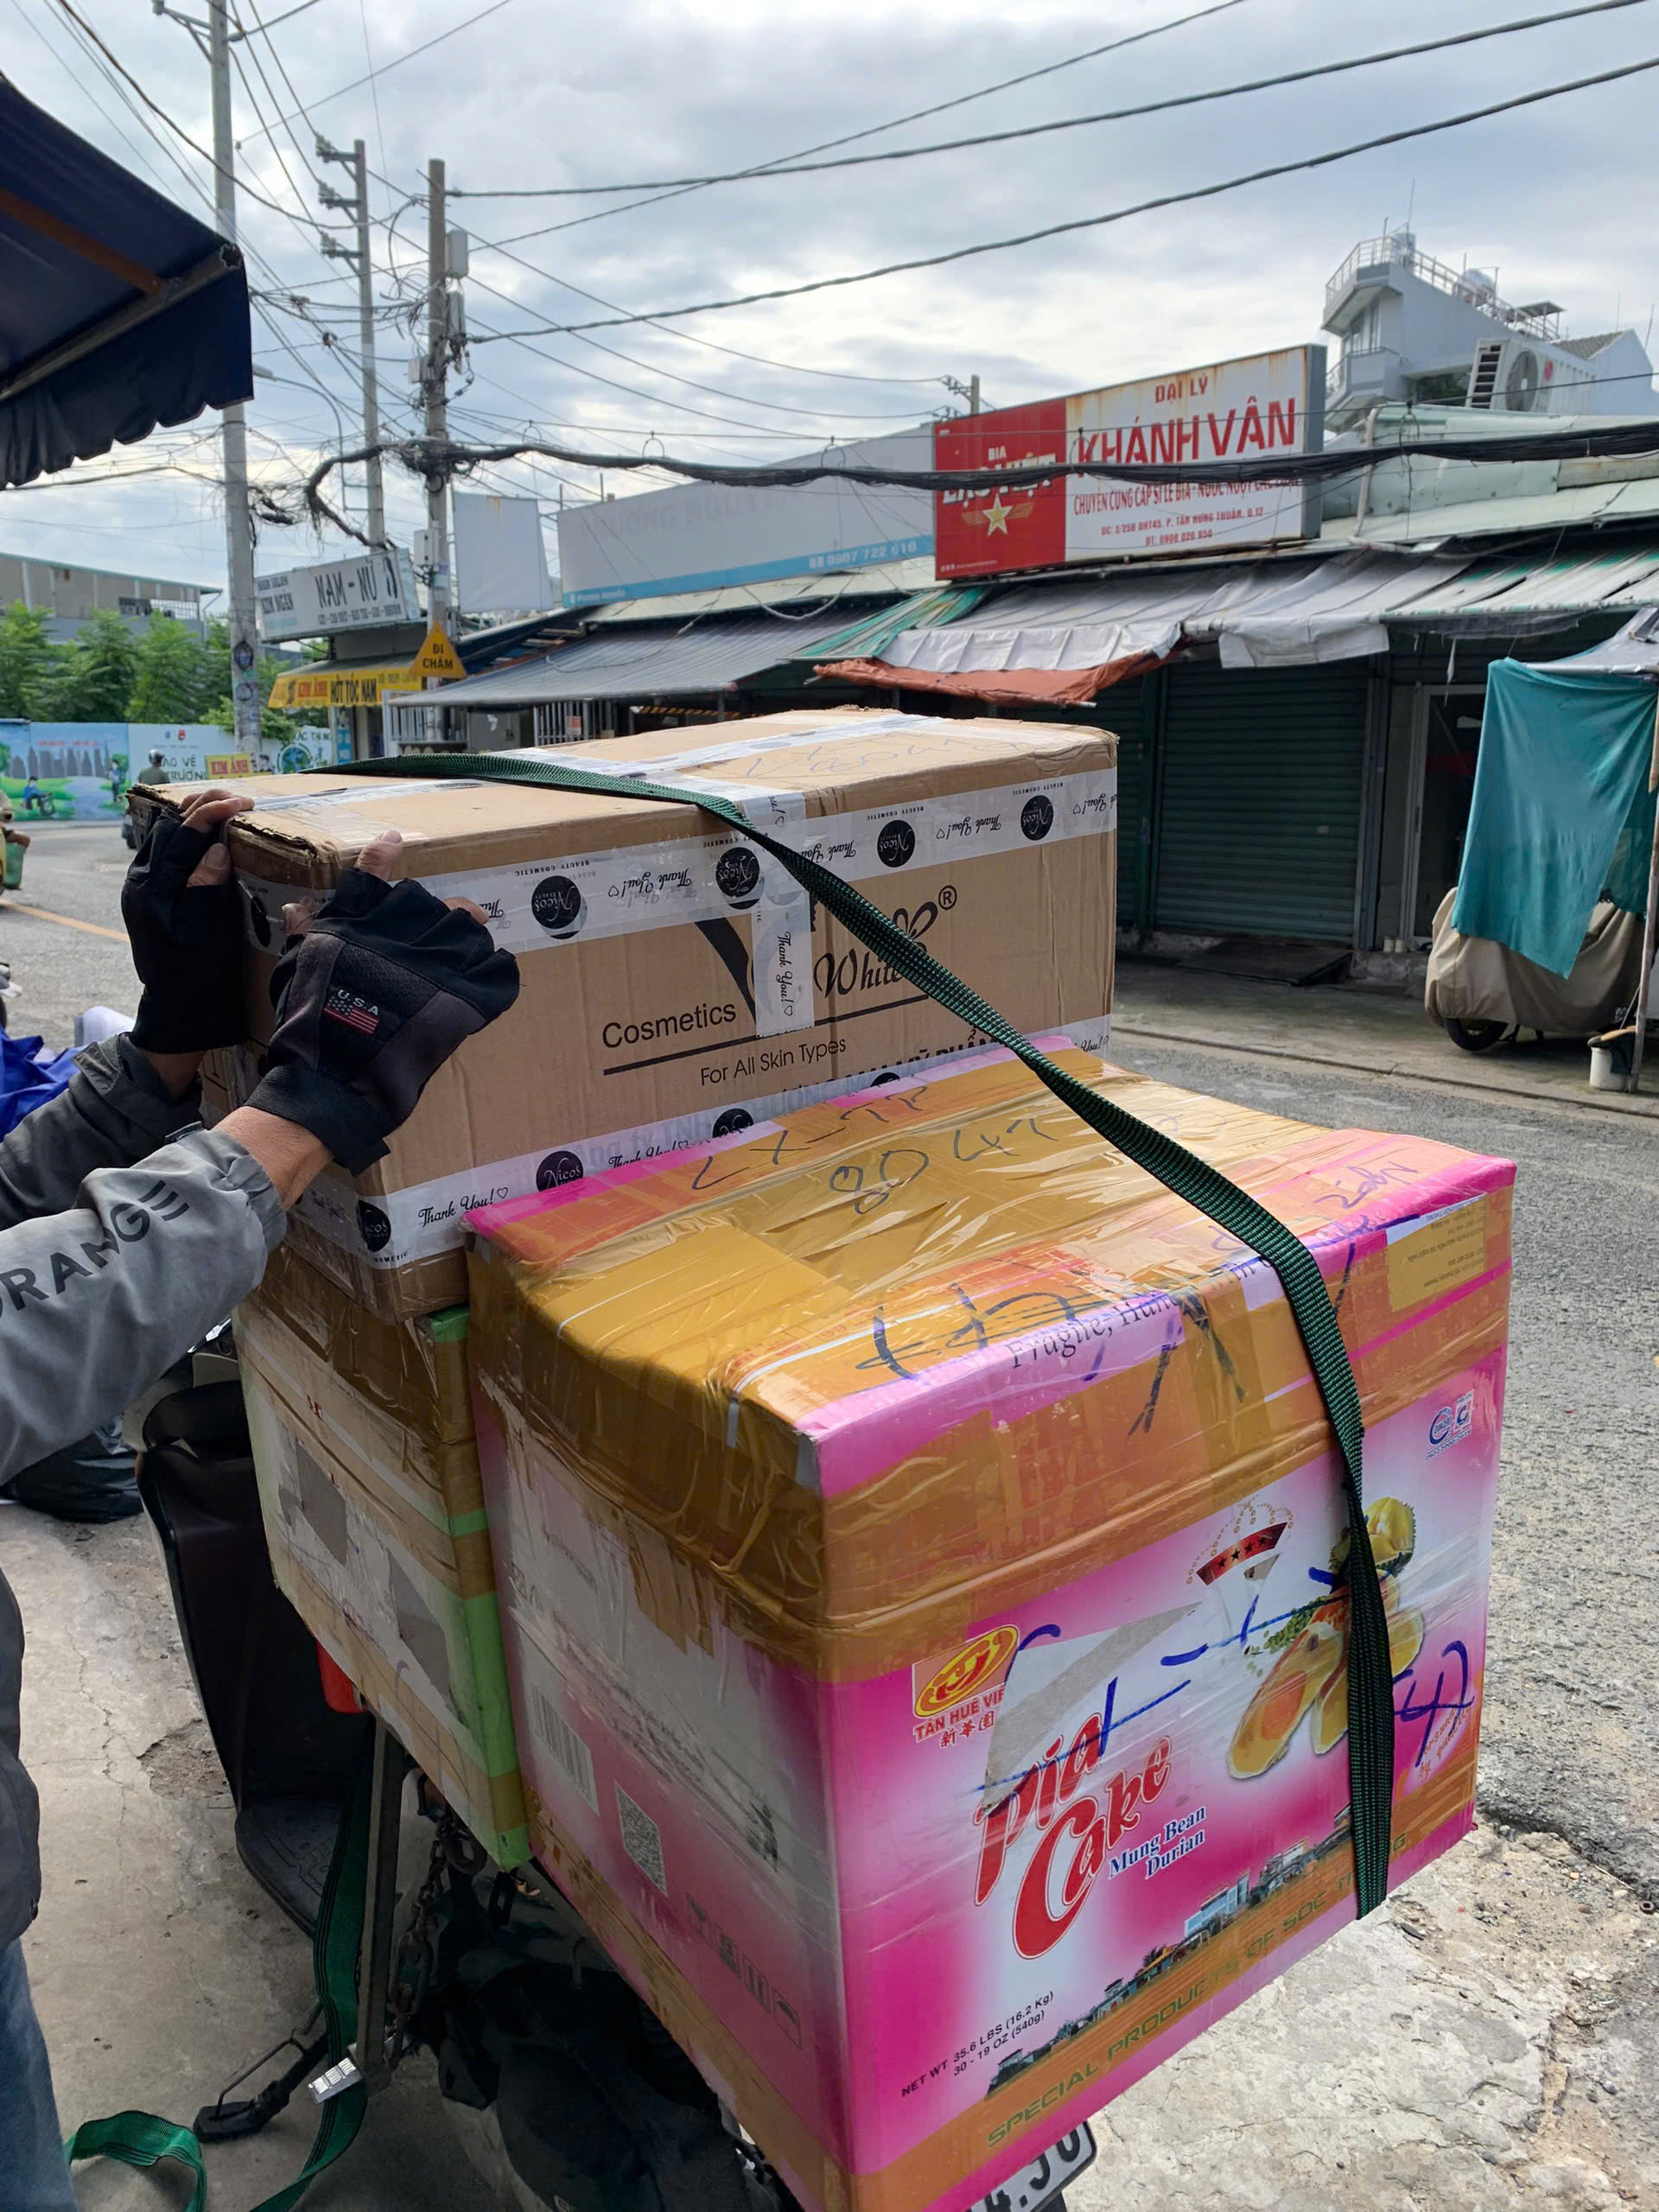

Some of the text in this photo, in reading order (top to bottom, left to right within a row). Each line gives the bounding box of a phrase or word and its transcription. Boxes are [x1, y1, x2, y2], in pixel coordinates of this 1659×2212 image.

[1154, 372, 1209, 405] ĐẠI LÝ
[1077, 395, 1296, 471] KHÁNH VÂN
[988, 445, 1007, 461] BIA
[315, 571, 347, 608] NAM
[346, 673, 360, 703] TÓC
[361, 678, 377, 702] NAM
[210, 755, 249, 775] KIM ÁNH
[866, 810, 898, 821] COSMETIC
[947, 813, 1002, 840] Thank You!
[1022, 803, 1052, 835] Nicos
[827, 840, 857, 858] Thank
[880, 829, 912, 861] Nicos
[514, 860, 590, 876] BEAUTY COSMETIC
[621, 872, 655, 898] You!
[657, 868, 692, 890] Thank
[534, 885, 576, 922] Nicos
[777, 930, 794, 1006] Thank You!
[813, 947, 905, 999] White
[601, 1001, 738, 1049] Cosmetics
[700, 1037, 847, 1087] For All Skin Types
[543, 1155, 582, 1189] Nicos
[417, 1187, 495, 1229] Thank You!
[0, 1179, 190, 1318] RANGE
[1002, 1315, 1114, 1370] Fragile,
[915, 1715, 945, 1739] TÂN
[1012, 1735, 1173, 1961] Cake
[1108, 1805, 1206, 1880] Mung Bean
[1145, 1829, 1205, 1879] Durian
[901, 1991, 1054, 2098] NET WT 35.6 LBS (16.2 Kg)
[953, 2061, 968, 2076] 30
[978, 2045, 990, 2060] 19
[993, 2032, 1009, 2050] OZ
[1011, 2010, 1046, 2039] (540g)
[987, 2063, 1100, 2149] SPECIAL
[1106, 1956, 1242, 2063] PRODUCTS
[1245, 1927, 1276, 1960] OF
